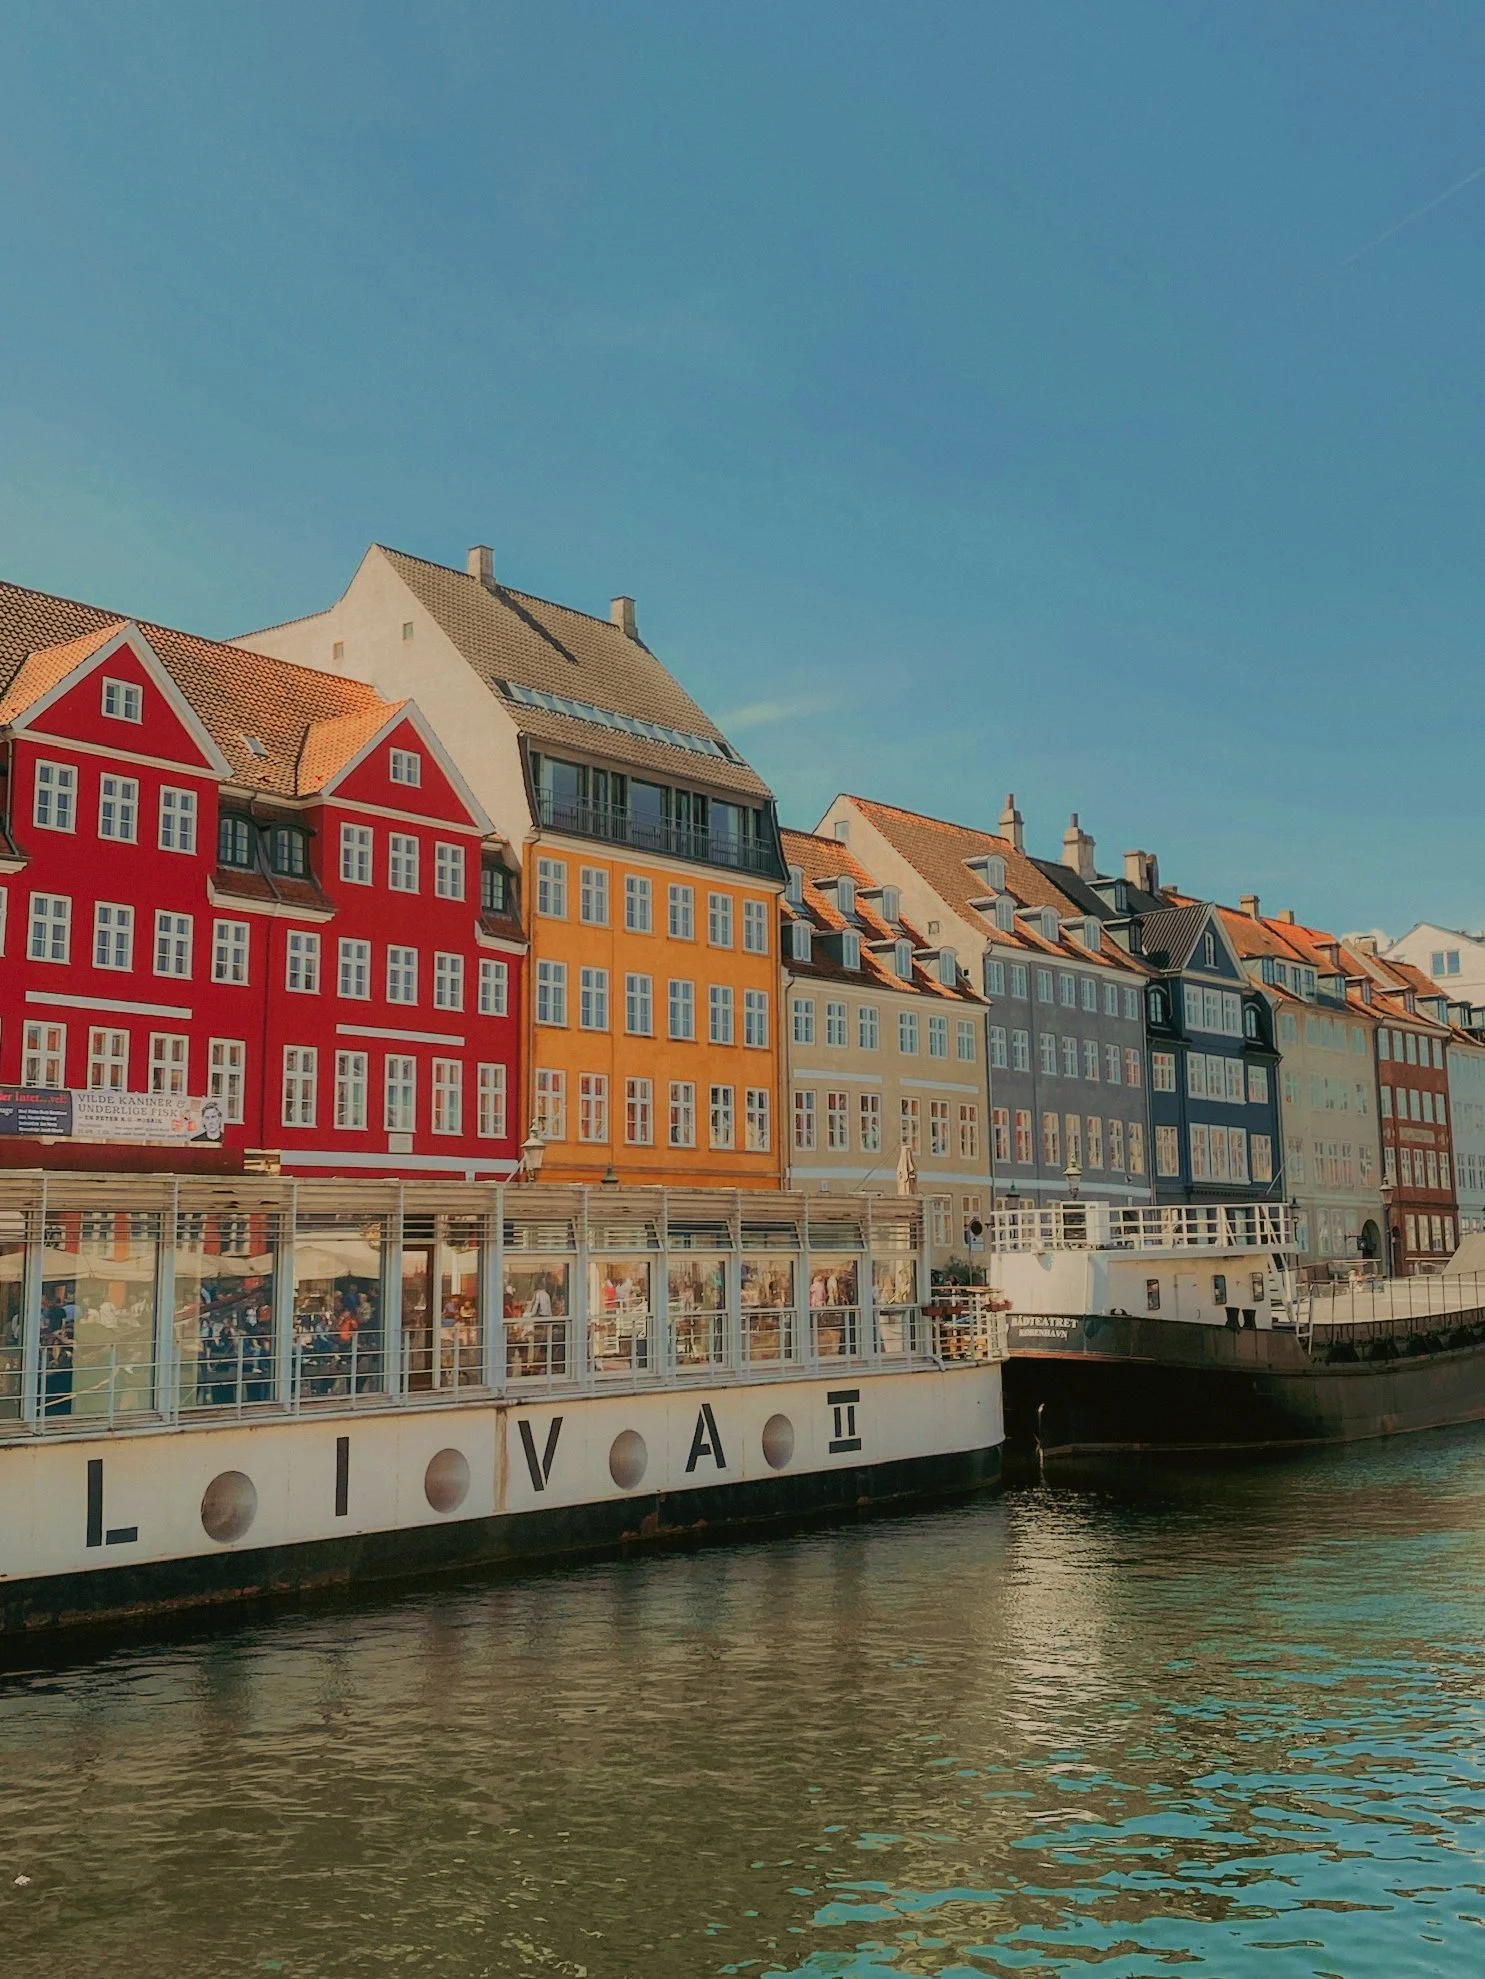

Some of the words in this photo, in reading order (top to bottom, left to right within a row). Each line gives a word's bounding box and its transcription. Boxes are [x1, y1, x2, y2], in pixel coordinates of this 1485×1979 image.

[78, 1094, 115, 1104] VILDE
[119, 1096, 172, 1107] KANINER
[176, 1100, 186, 1108] &
[78, 1104, 150, 1116] UNDERLIGE
[151, 1108, 178, 1117] FISK
[1011, 1315, 1078, 1329] BÅDTEATRET
[1019, 1328, 1068, 1340] KØBENHAVN
